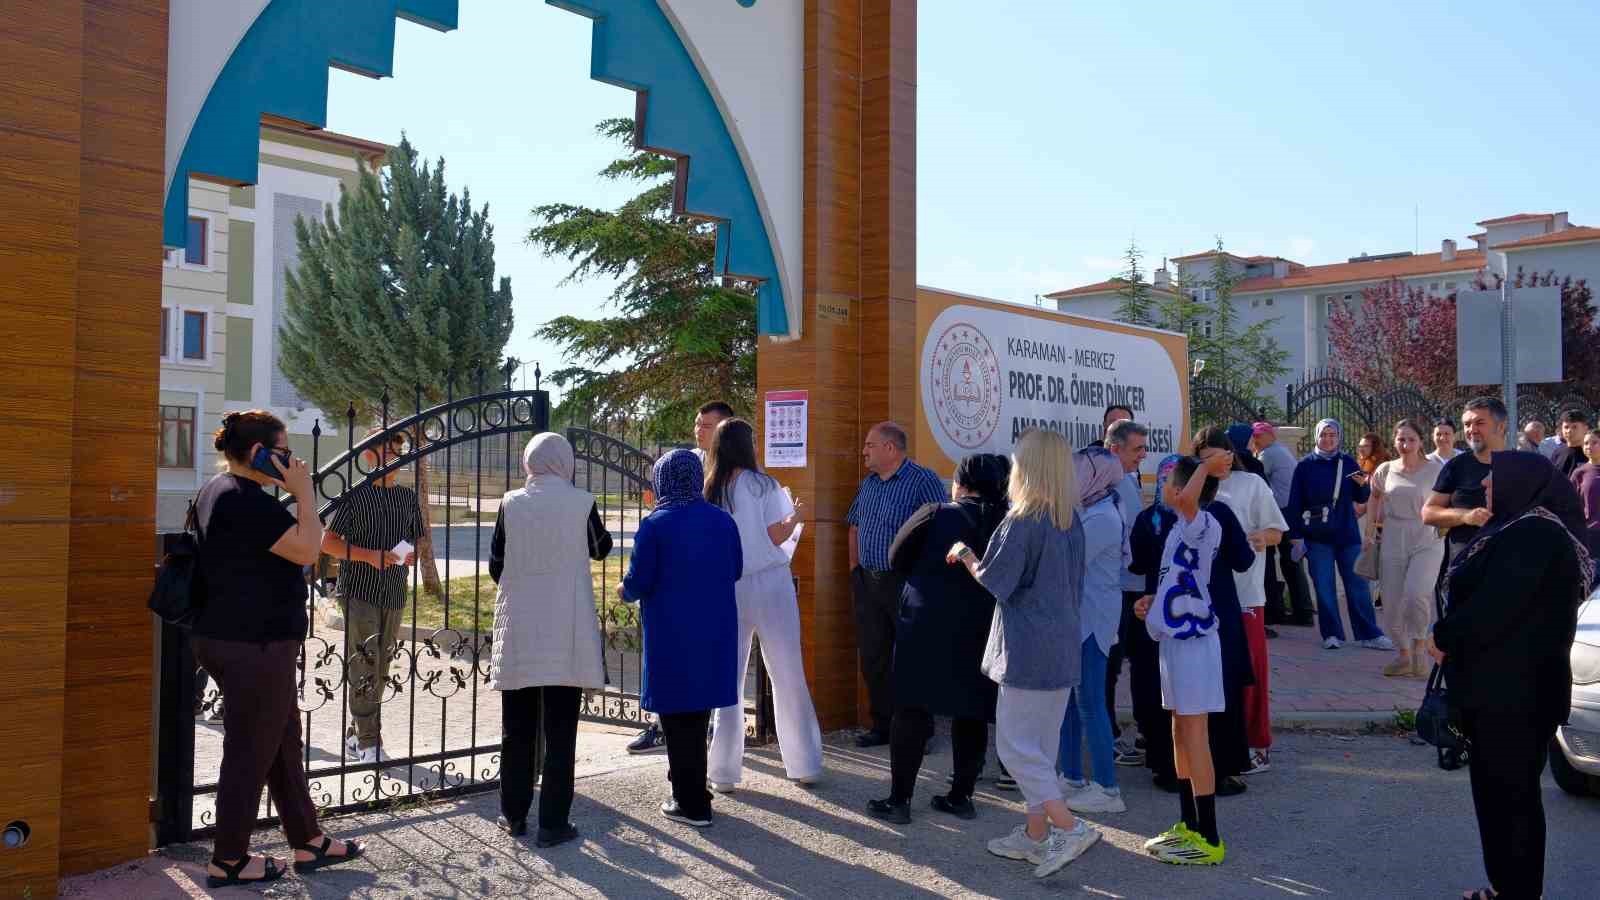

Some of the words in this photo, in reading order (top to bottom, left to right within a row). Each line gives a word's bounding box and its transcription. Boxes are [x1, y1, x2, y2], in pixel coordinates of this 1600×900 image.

[1007, 337, 1066, 364] KARAMAN
[1074, 348, 1116, 371] MERKEZ
[1008, 370, 1046, 402] PROF.
[1047, 375, 1069, 404] DR.
[1070, 372, 1104, 408] ÖMER
